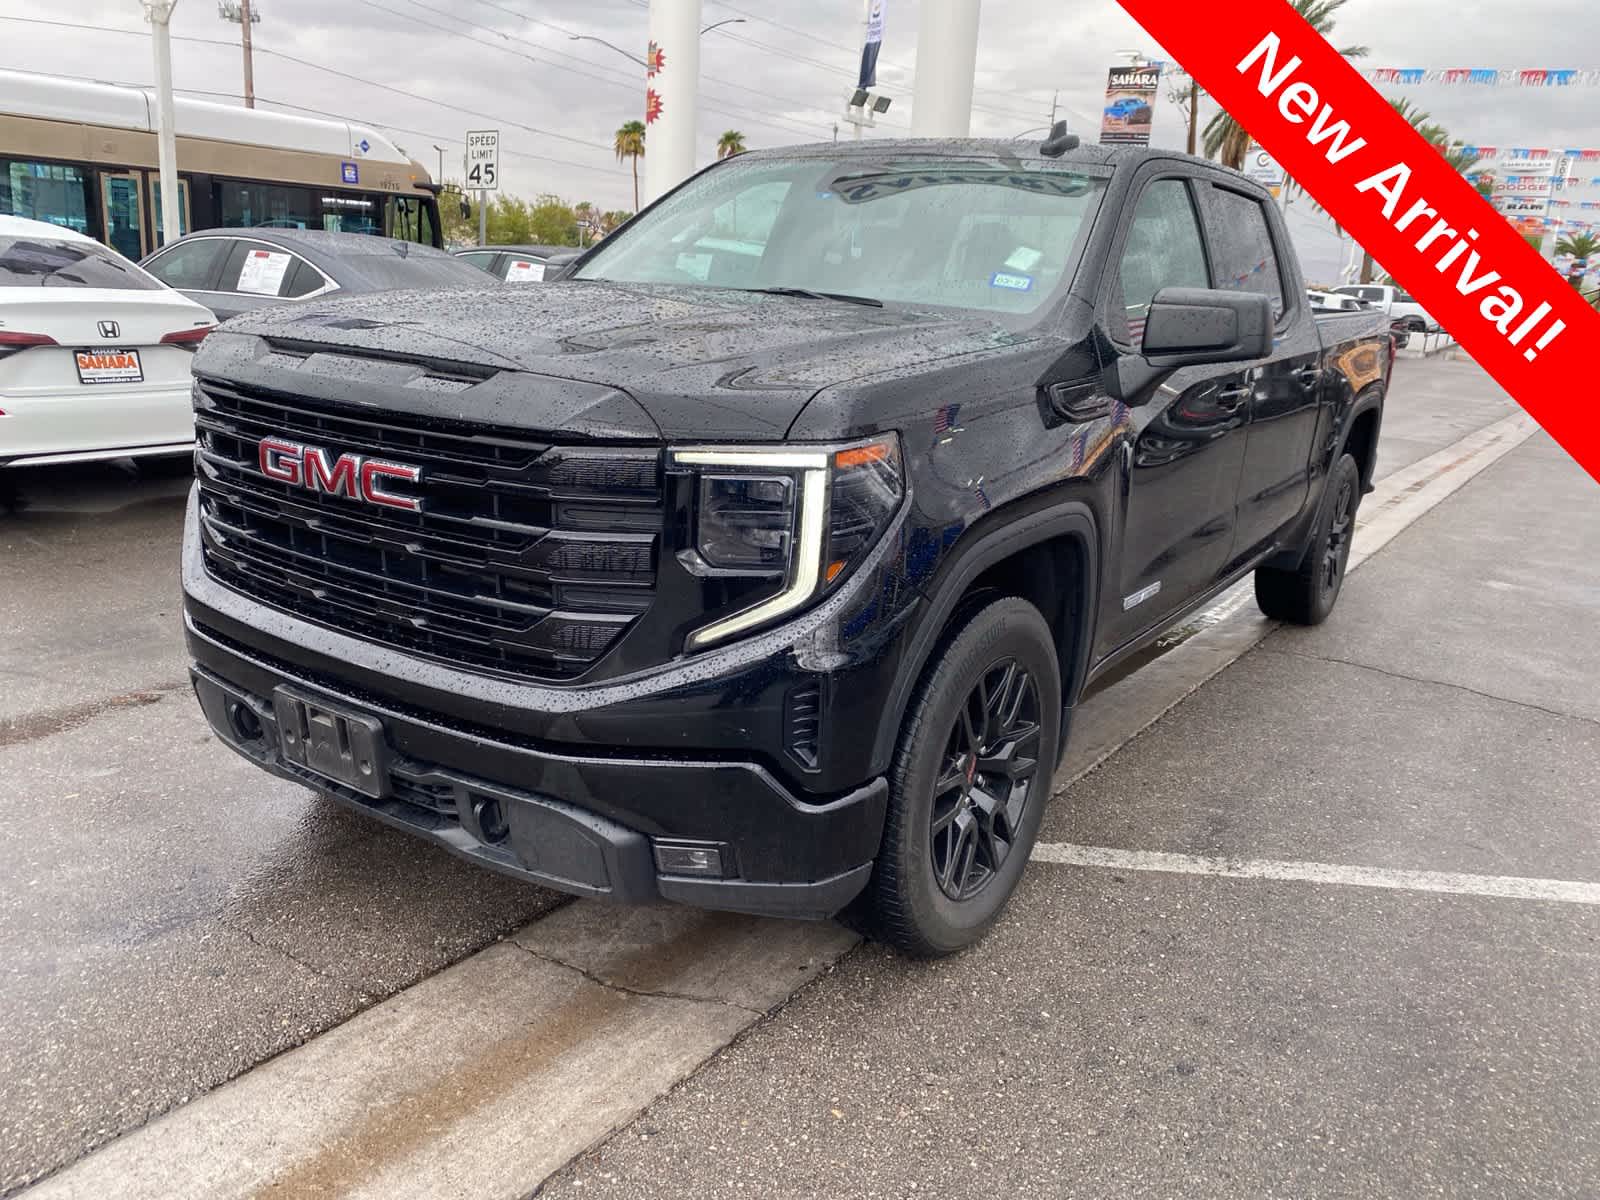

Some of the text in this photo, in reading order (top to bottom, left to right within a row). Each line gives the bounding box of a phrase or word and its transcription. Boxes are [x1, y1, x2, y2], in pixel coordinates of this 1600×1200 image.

[1111, 74, 1157, 85] SAHARA
[470, 136, 496, 146] SPEED
[471, 150, 493, 160] LIMIT
[469, 163, 495, 185] 45
[78, 354, 138, 369] SAHARA
[258, 435, 422, 513] GMC
